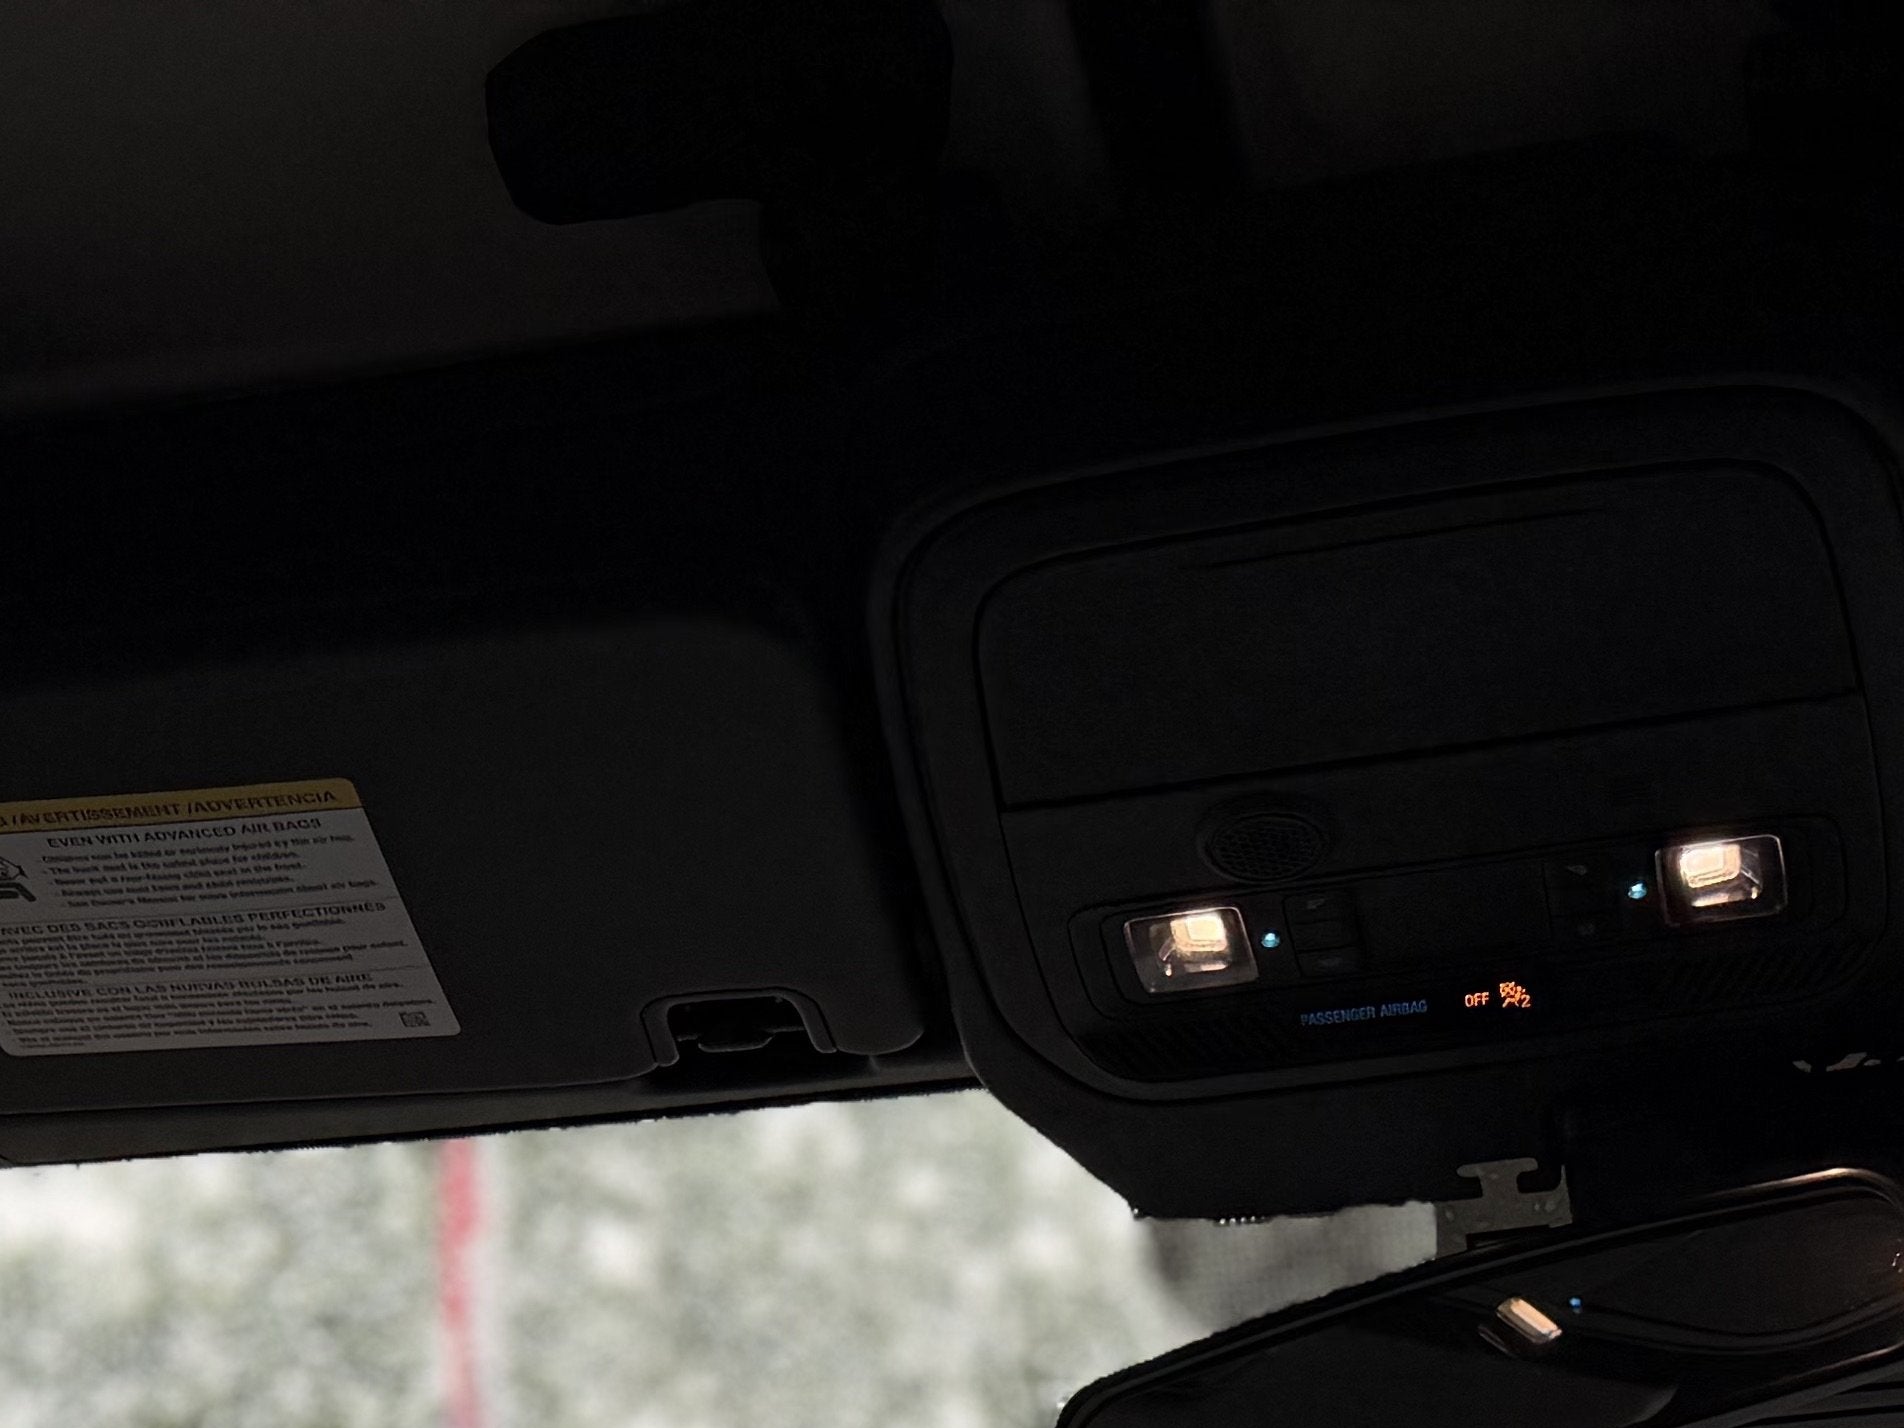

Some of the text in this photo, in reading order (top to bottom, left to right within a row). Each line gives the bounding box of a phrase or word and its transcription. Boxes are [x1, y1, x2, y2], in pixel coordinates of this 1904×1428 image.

[46, 818, 321, 848] EVEN WITH ADVANCED AIR BAGS
[1300, 991, 1490, 1027] PASSENGER AIRBAG OFF
